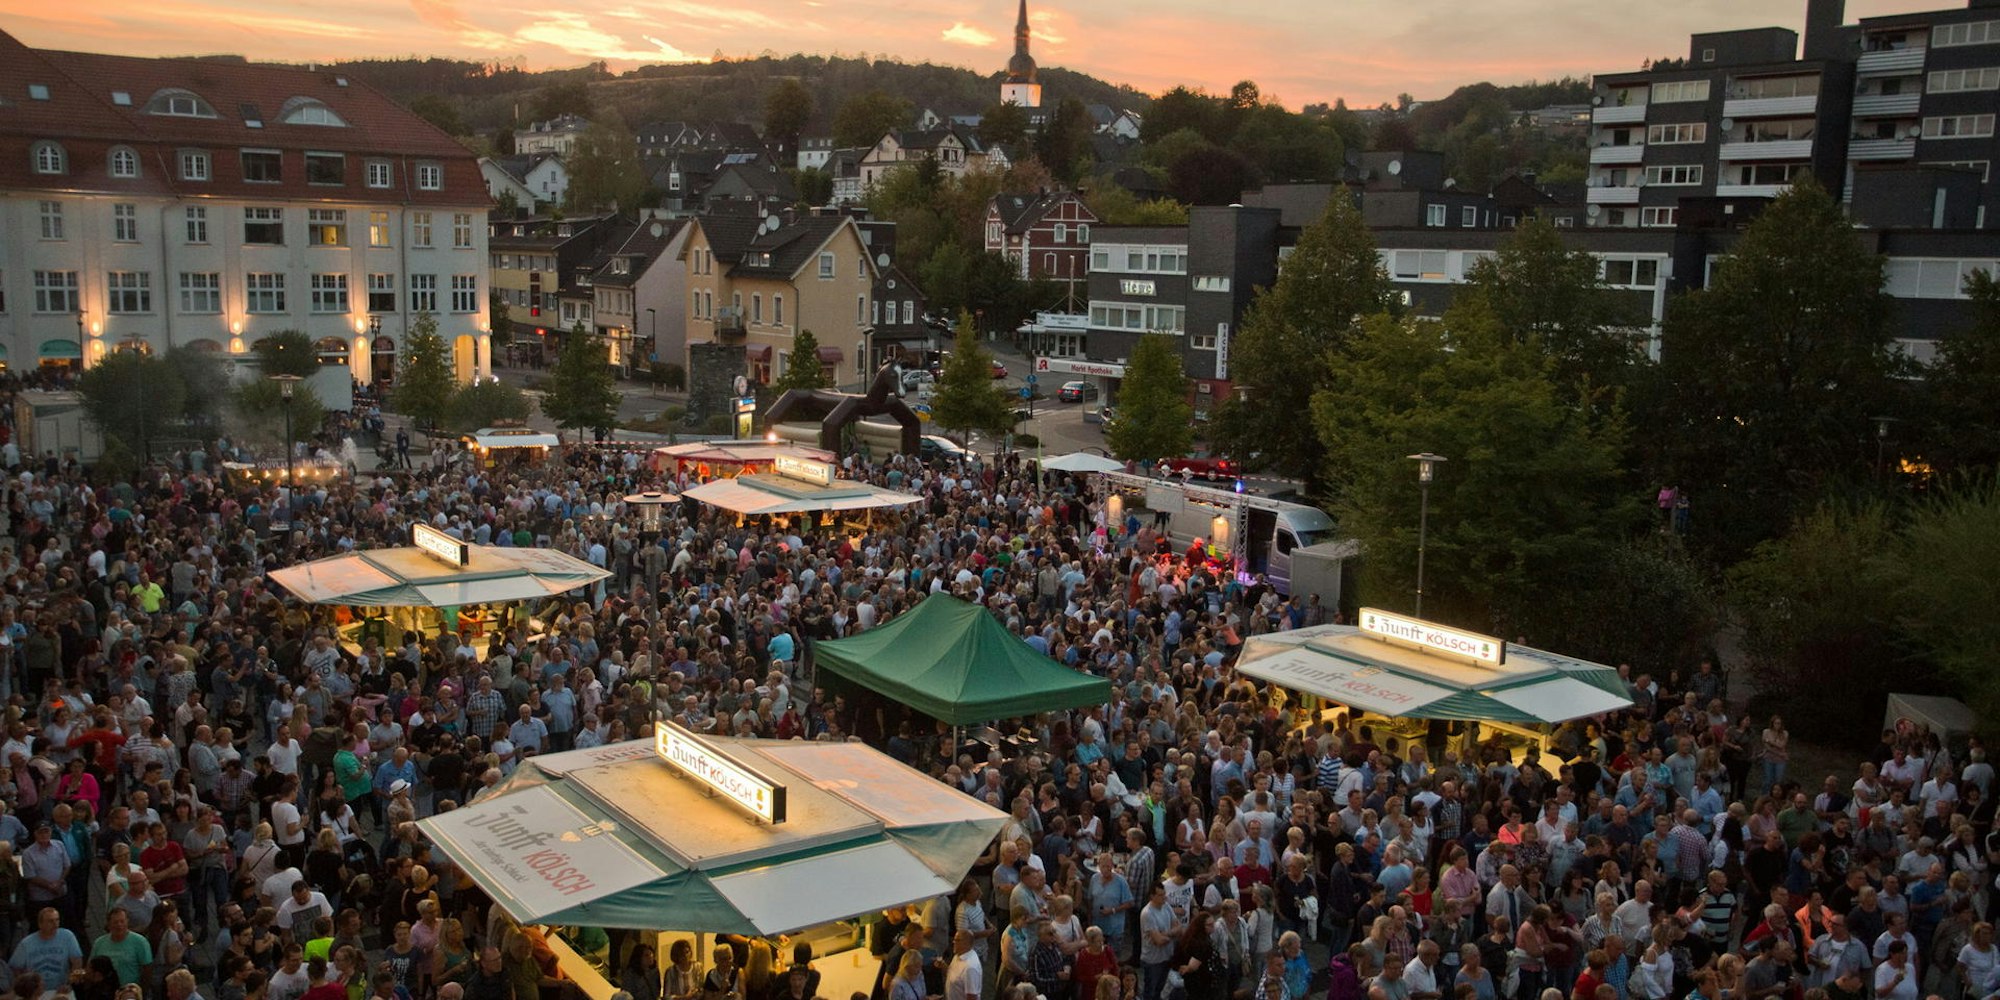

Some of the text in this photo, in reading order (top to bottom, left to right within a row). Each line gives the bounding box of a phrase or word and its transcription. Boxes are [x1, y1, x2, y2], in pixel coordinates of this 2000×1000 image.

[1380, 618, 1476, 653] Zunft KÖLSCH
[1342, 680, 1414, 704] KÖLSCH
[672, 740, 708, 774] Zunft
[709, 766, 752, 801] KÖLSCH
[464, 805, 596, 895] Zunft KÖLSCH
